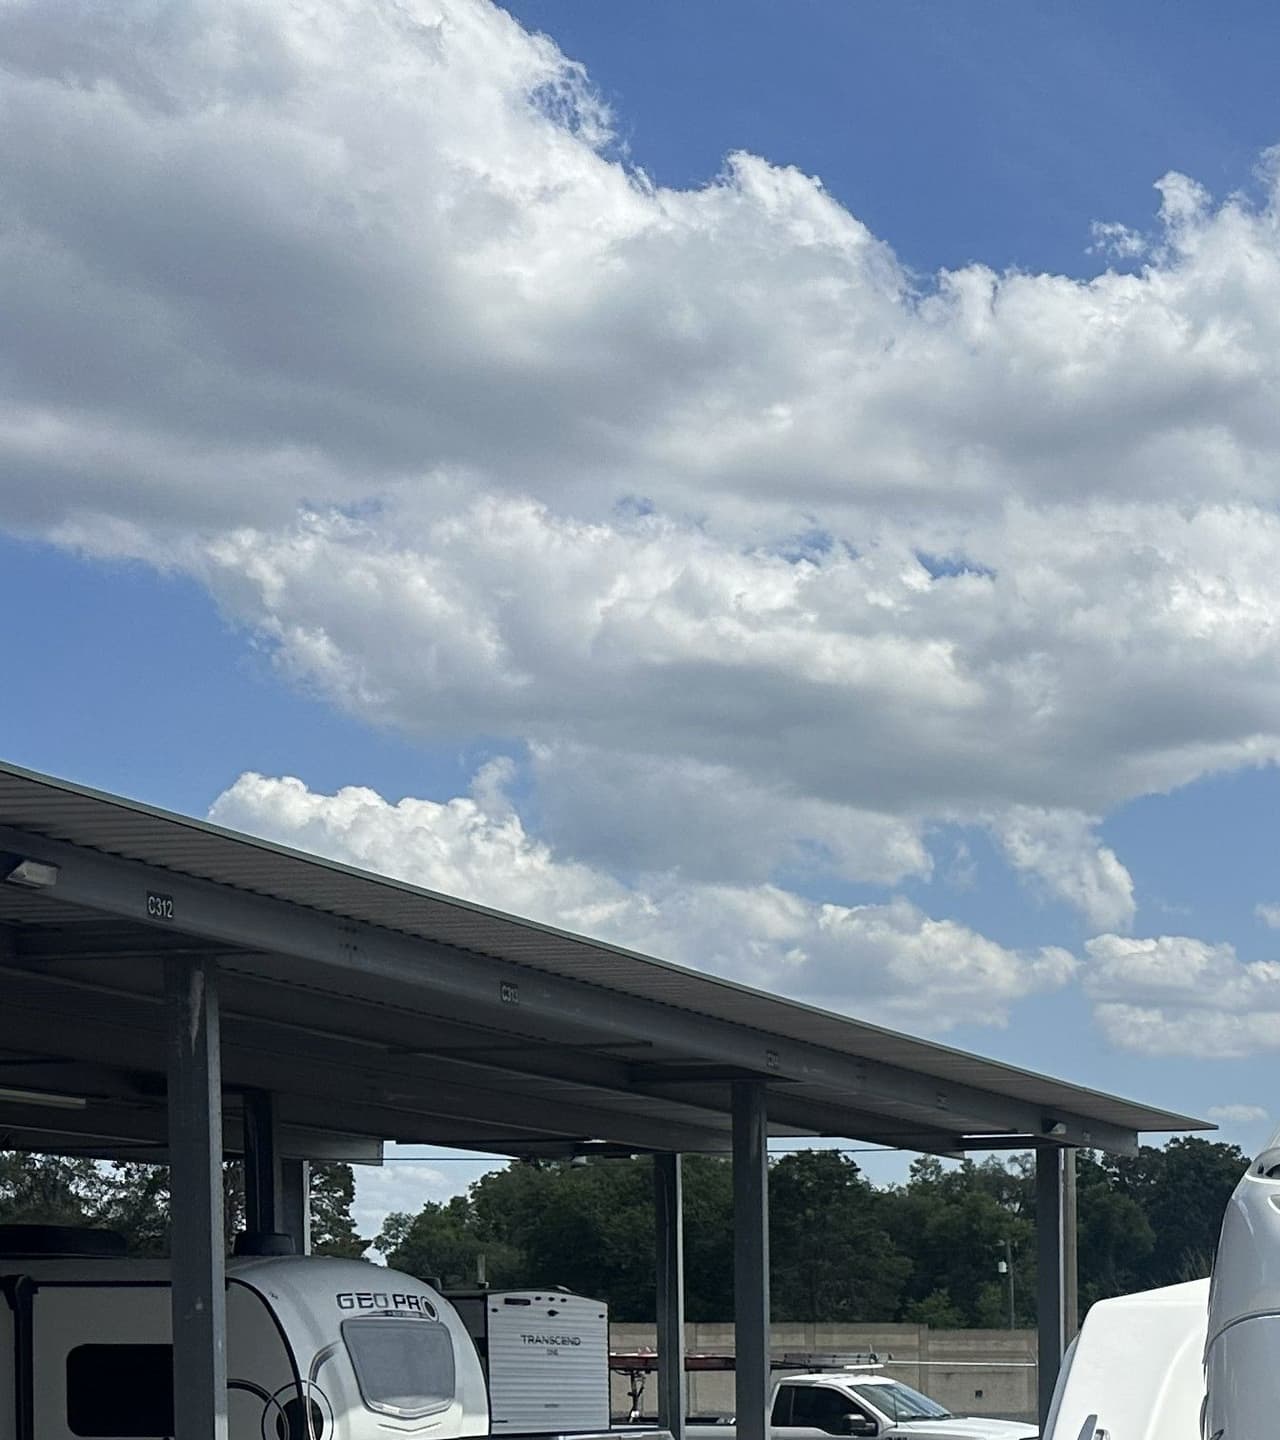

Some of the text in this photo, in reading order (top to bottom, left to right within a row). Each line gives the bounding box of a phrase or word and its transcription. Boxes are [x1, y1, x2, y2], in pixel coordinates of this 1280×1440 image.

[148, 896, 173, 918] C312
[336, 1292, 440, 1323] GEO PRO
[520, 1334, 581, 1346] TRANSCEND
